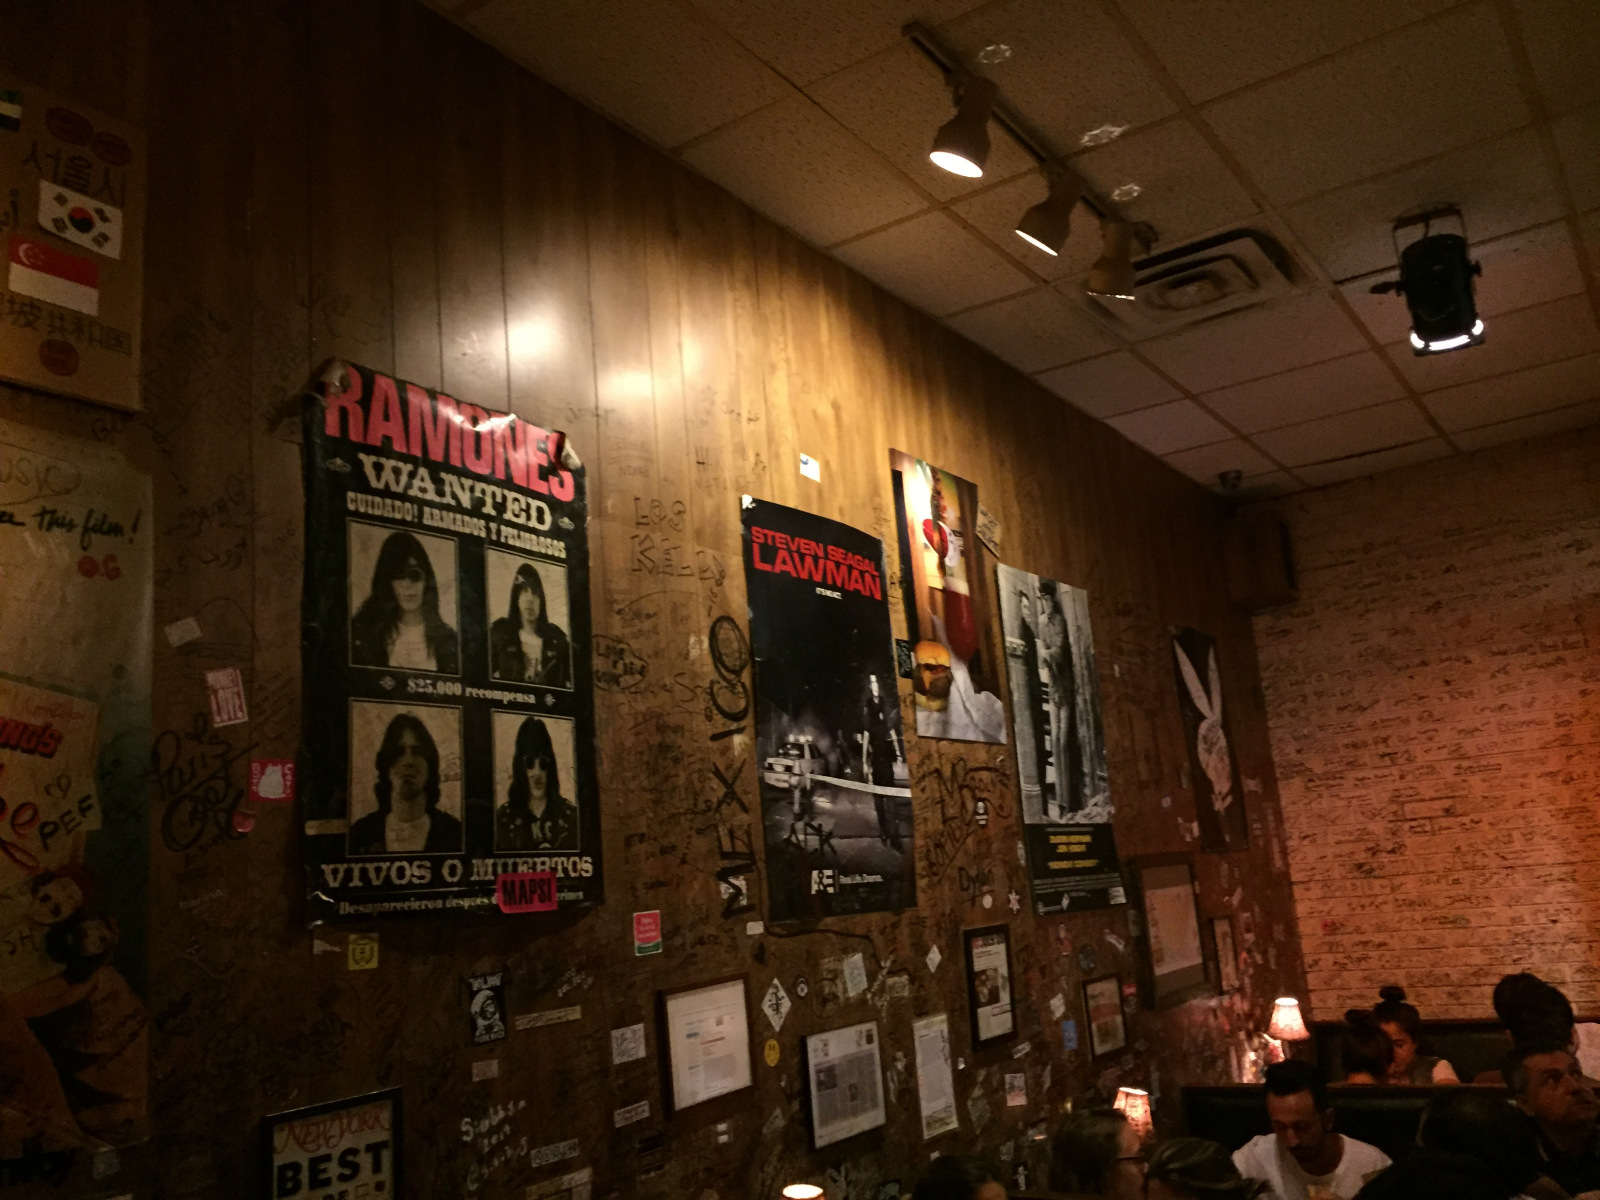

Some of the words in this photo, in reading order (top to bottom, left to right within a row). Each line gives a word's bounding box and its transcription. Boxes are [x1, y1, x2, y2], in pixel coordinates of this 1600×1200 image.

[323, 365, 575, 503] RAMONES
[346, 491, 419, 523] CUIDADO!
[422, 507, 487, 538] ARMADOS
[488, 520, 499, 541] Y
[357, 452, 553, 531] WANTED
[750, 525, 824, 558] STEVEN
[826, 544, 879, 577] SEAGAL
[751, 542, 882, 601] LAWMAN
[465, 685, 537, 705] recompensa
[320, 860, 432, 888] VIVOS
[441, 859, 464, 883] O
[470, 856, 594, 881] MUERTOS
[338, 897, 443, 916] Desaparecieron
[277, 1140, 390, 1199] BEST
